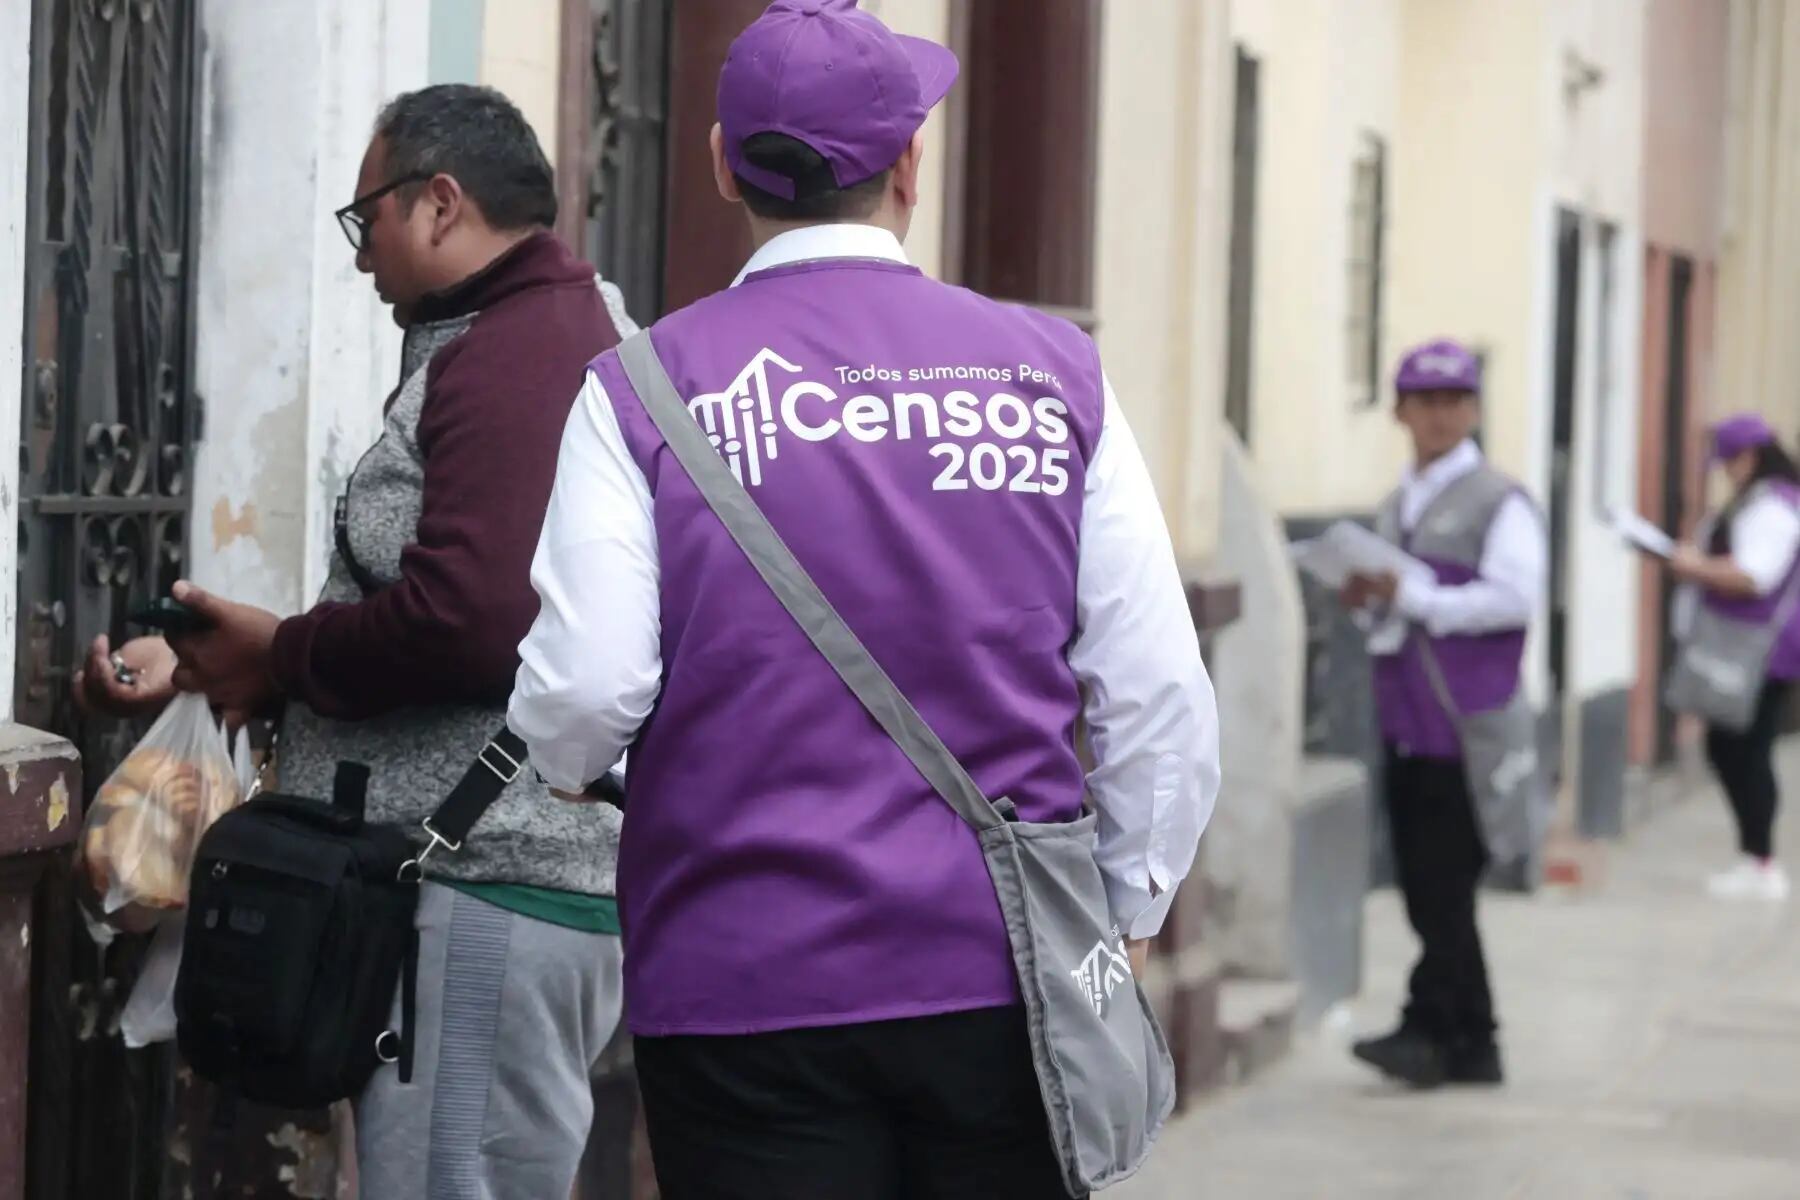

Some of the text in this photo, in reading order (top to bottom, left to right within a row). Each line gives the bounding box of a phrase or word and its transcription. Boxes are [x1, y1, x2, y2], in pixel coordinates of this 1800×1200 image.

[834, 363, 902, 384] Todos
[908, 366, 1012, 382] sumamos
[780, 381, 1069, 443] Censos
[928, 442, 1070, 496] 2025
